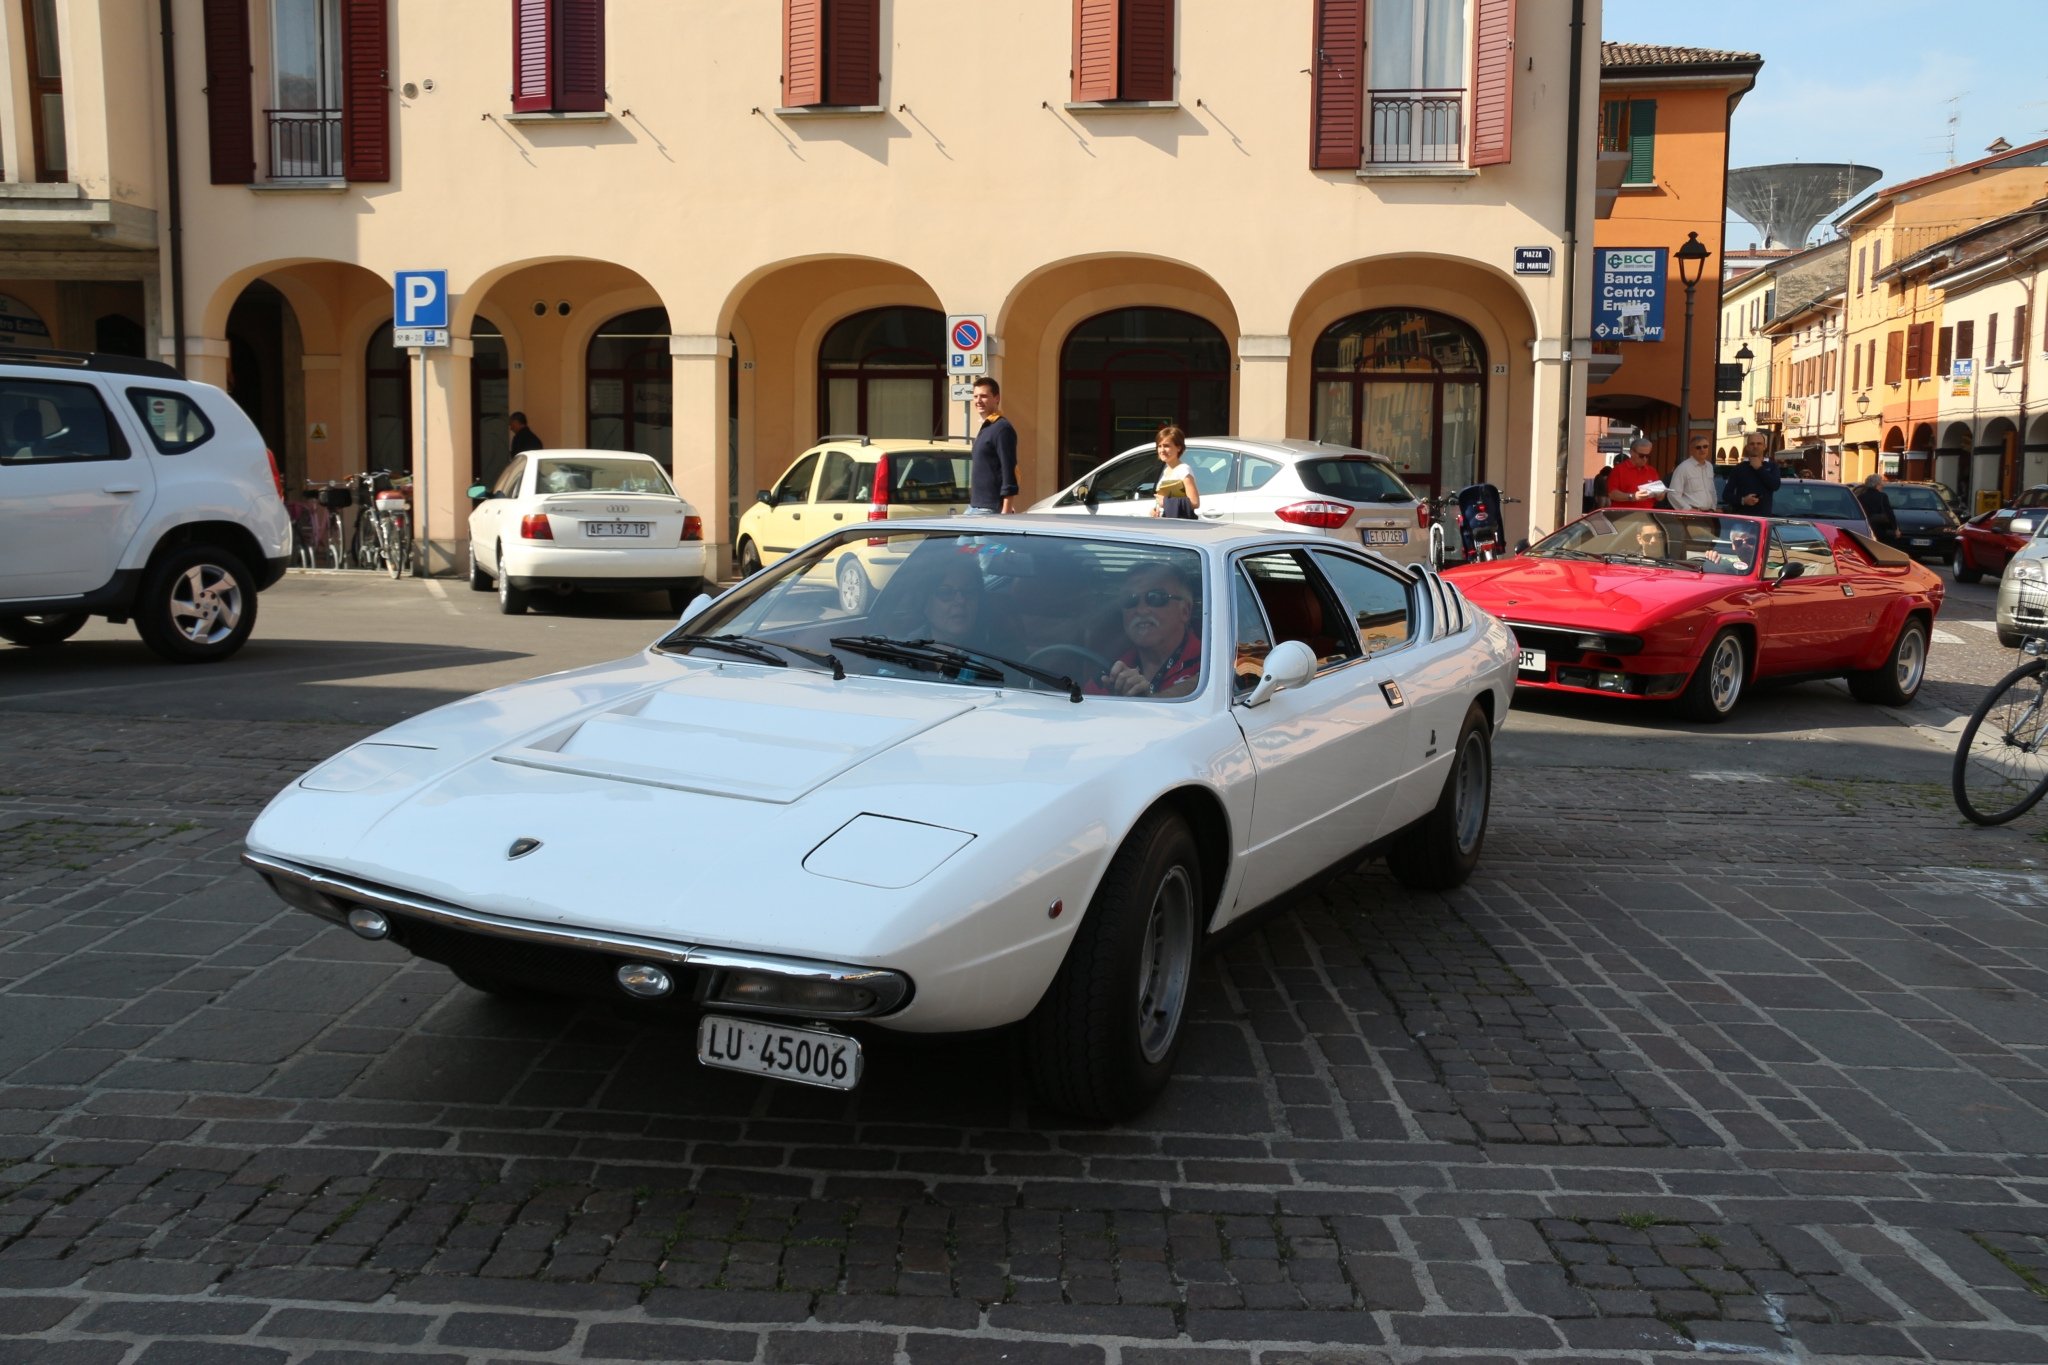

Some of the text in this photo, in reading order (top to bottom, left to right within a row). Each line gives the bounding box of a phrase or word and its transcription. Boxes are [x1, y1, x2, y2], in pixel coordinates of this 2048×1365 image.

[1624, 254, 1653, 264] BCC
[1516, 262, 1549, 270] DEI MARTIRI
[1604, 272, 1653, 284] Banca
[1603, 286, 1656, 298] Centro
[405, 276, 436, 322] P
[1603, 299, 1651, 311] Emilia
[1612, 326, 1661, 335] BAMAT
[954, 355, 962, 366] P
[1495, 365, 1505, 373] 23
[1787, 401, 1801, 412] BAR
[590, 523, 647, 535] AF 137 TP
[1369, 530, 1379, 542] ET
[760, 1033, 847, 1080] 45006
